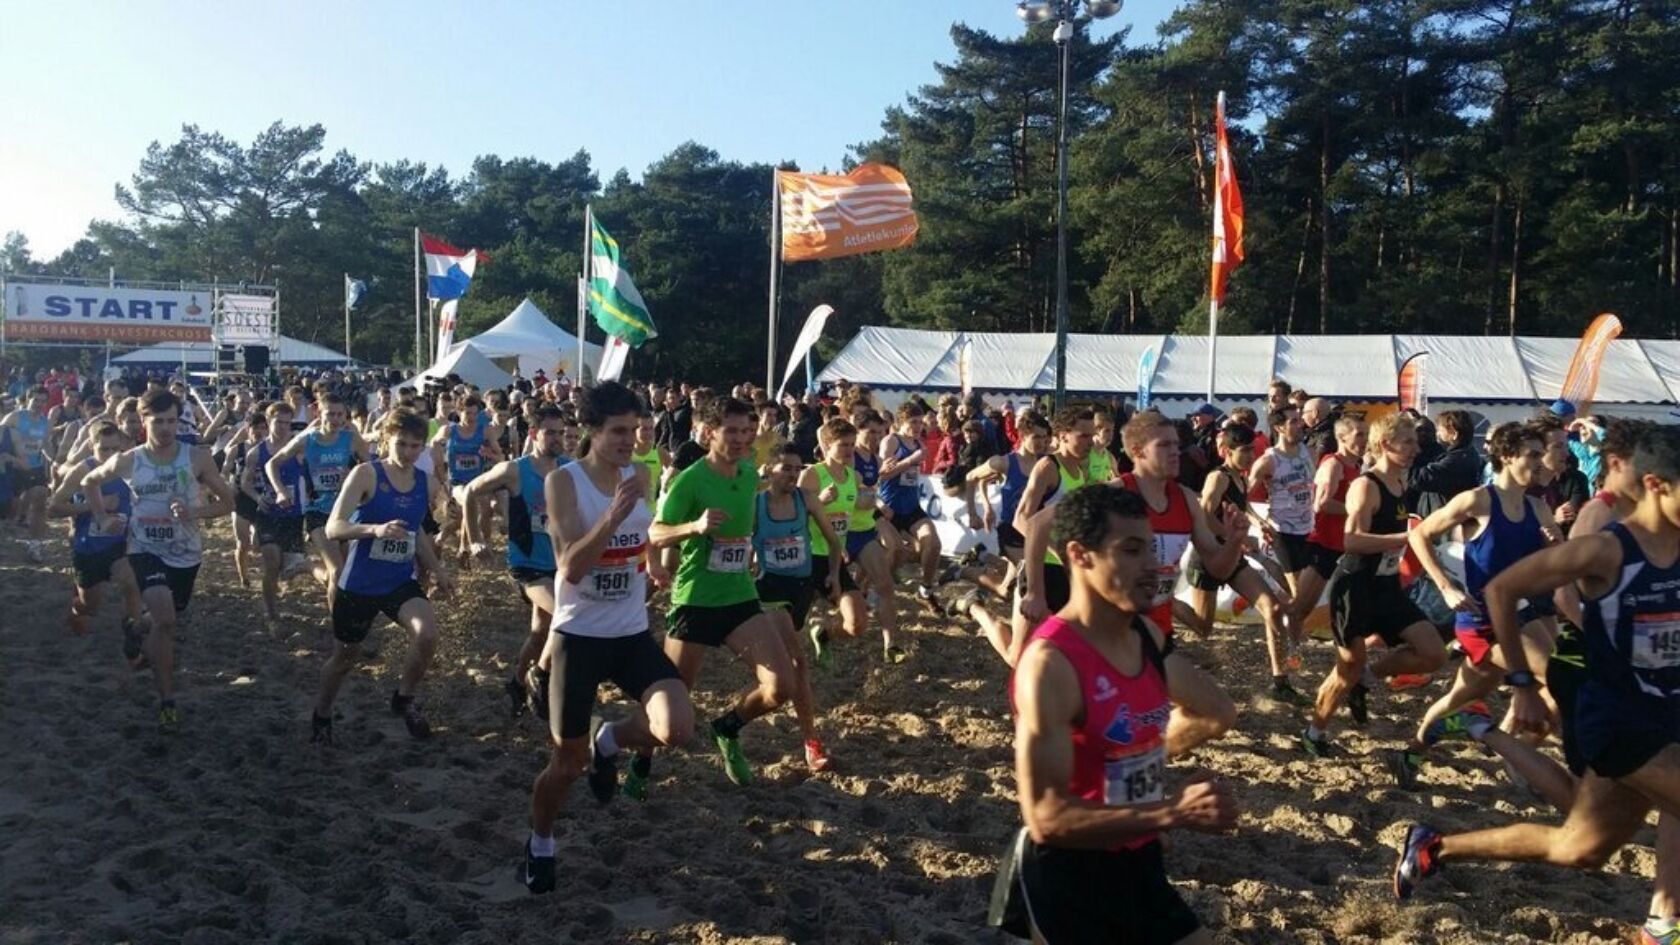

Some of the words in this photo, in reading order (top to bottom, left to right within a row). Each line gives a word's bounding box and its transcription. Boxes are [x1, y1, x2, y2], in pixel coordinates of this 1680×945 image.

[44, 294, 178, 320] START
[10, 324, 88, 337] RABOBANK
[94, 326, 209, 340] SYLVESTERCROSS
[382, 539, 409, 554] 1518
[774, 546, 799, 562] 1547
[721, 547, 746, 563] 1517
[593, 571, 630, 591] 1501
